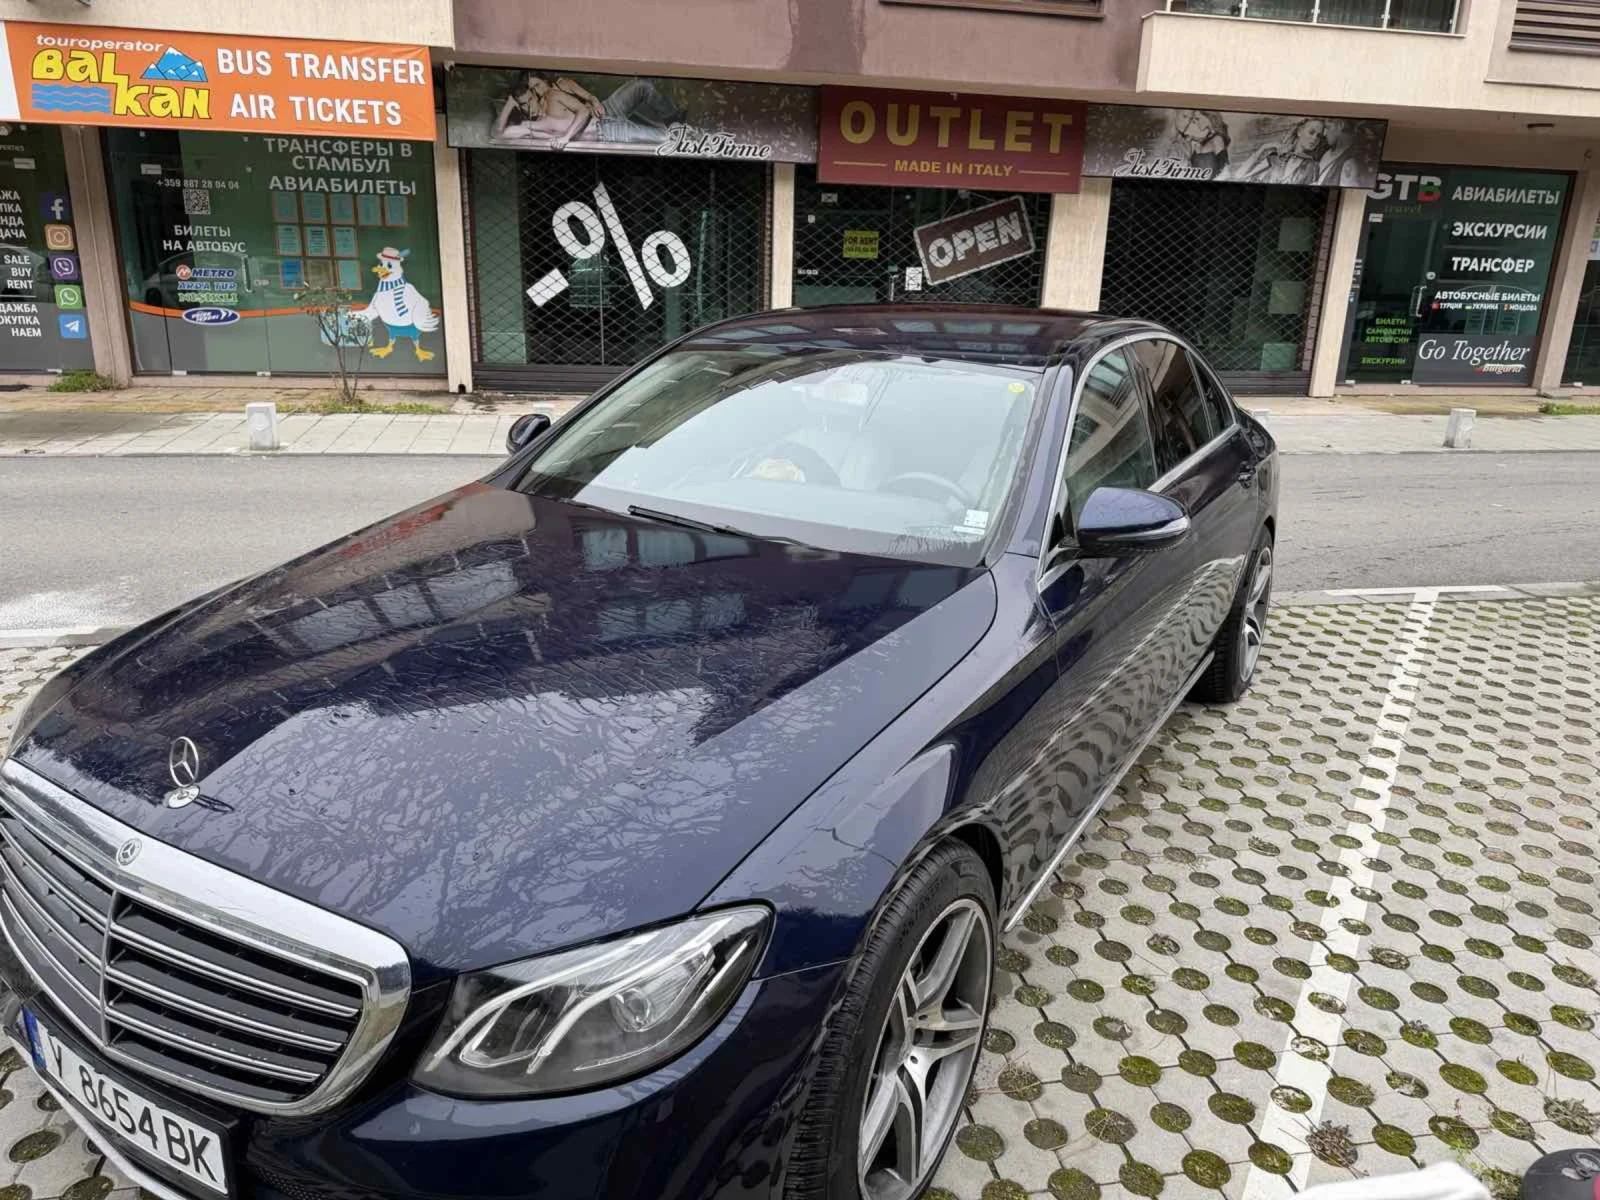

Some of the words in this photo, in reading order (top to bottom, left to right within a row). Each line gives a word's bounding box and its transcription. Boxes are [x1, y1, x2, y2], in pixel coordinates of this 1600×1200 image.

[36, 34, 164, 52] touroperator
[217, 48, 272, 77] BUS
[284, 52, 426, 86] TRANSFER
[230, 93, 276, 119] AIR
[289, 95, 402, 126] TICKETS
[840, 100, 1073, 154] OUTLET
[264, 137, 393, 157] ТРАНСФЕРЫ
[401, 141, 412, 157] В
[292, 155, 390, 173] СТАМБУЛ
[894, 159, 941, 173] MADE
[946, 161, 963, 174] IN
[967, 162, 1013, 177] ITALY
[156, 179, 181, 188] +359
[215, 181, 226, 189] 04
[228, 181, 239, 190] 04
[269, 175, 416, 196] АВИАБИЛЕТЫ
[1367, 172, 1442, 203] GTB
[0, 190, 20, 201] ЖА
[1452, 185, 1560, 205] АВИАБИЛЕТЫ
[174, 224, 231, 237] БИЛЕТЫ
[928, 211, 1023, 268] OPEN
[1452, 221, 1548, 240] ЭКСКУРСИИ
[163, 239, 183, 251] НА
[186, 241, 246, 253] АВТОБУС
[3, 254, 31, 265] SALE
[1452, 257, 1535, 274] ТРАНСФЕР
[11, 267, 32, 277] BUY
[192, 268, 236, 278] METRO
[7, 279, 33, 289] RENT
[1435, 291, 1499, 301] АВТОБУСНЫЕ
[1501, 292, 1541, 302] БИЛЕТЫ
[11, 327, 42, 337] НАЕМ
[1418, 339, 1446, 360] Go
[1451, 339, 1530, 366] Together
[78, 1064, 159, 1151] 8654
[163, 1116, 219, 1183] BK
